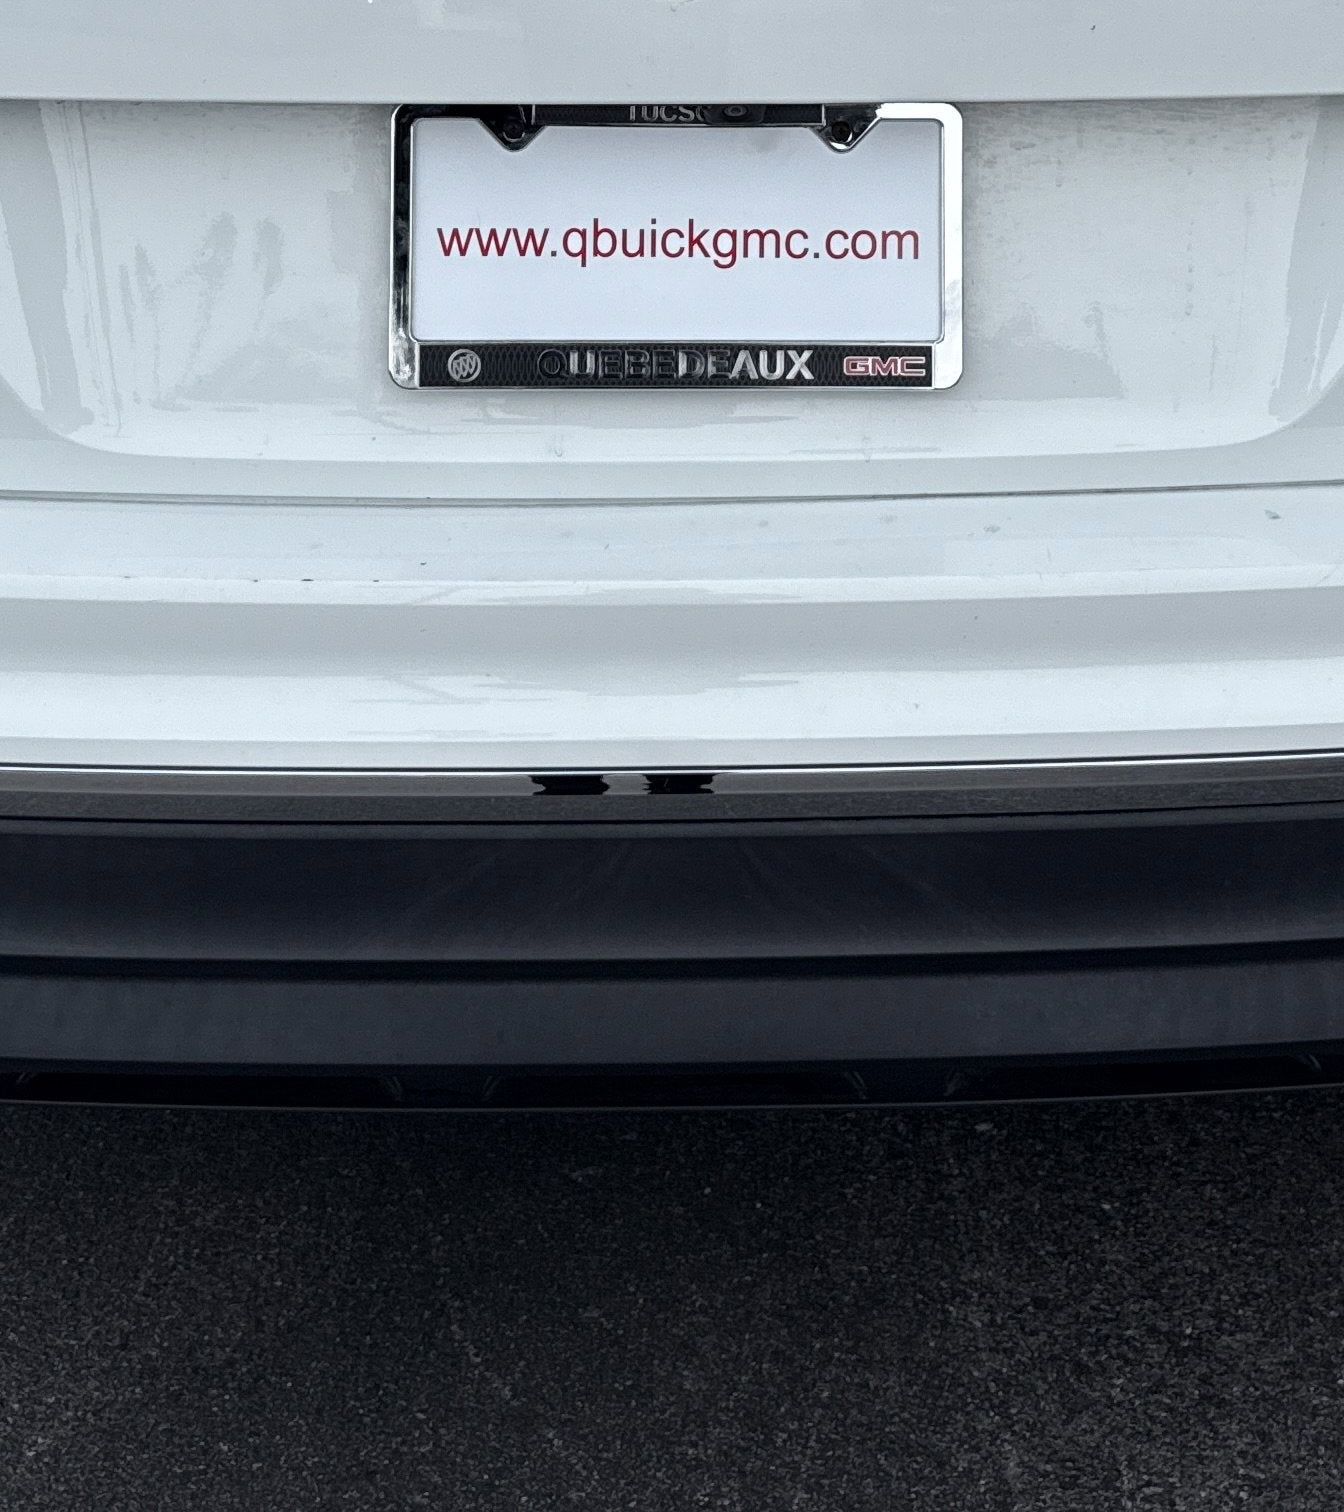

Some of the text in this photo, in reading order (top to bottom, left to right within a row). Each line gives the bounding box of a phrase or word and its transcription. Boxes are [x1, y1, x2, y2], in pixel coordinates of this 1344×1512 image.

[436, 218, 920, 269] www.qbuickgmc.com
[537, 349, 927, 382] QUEBEDEAUX GMC
